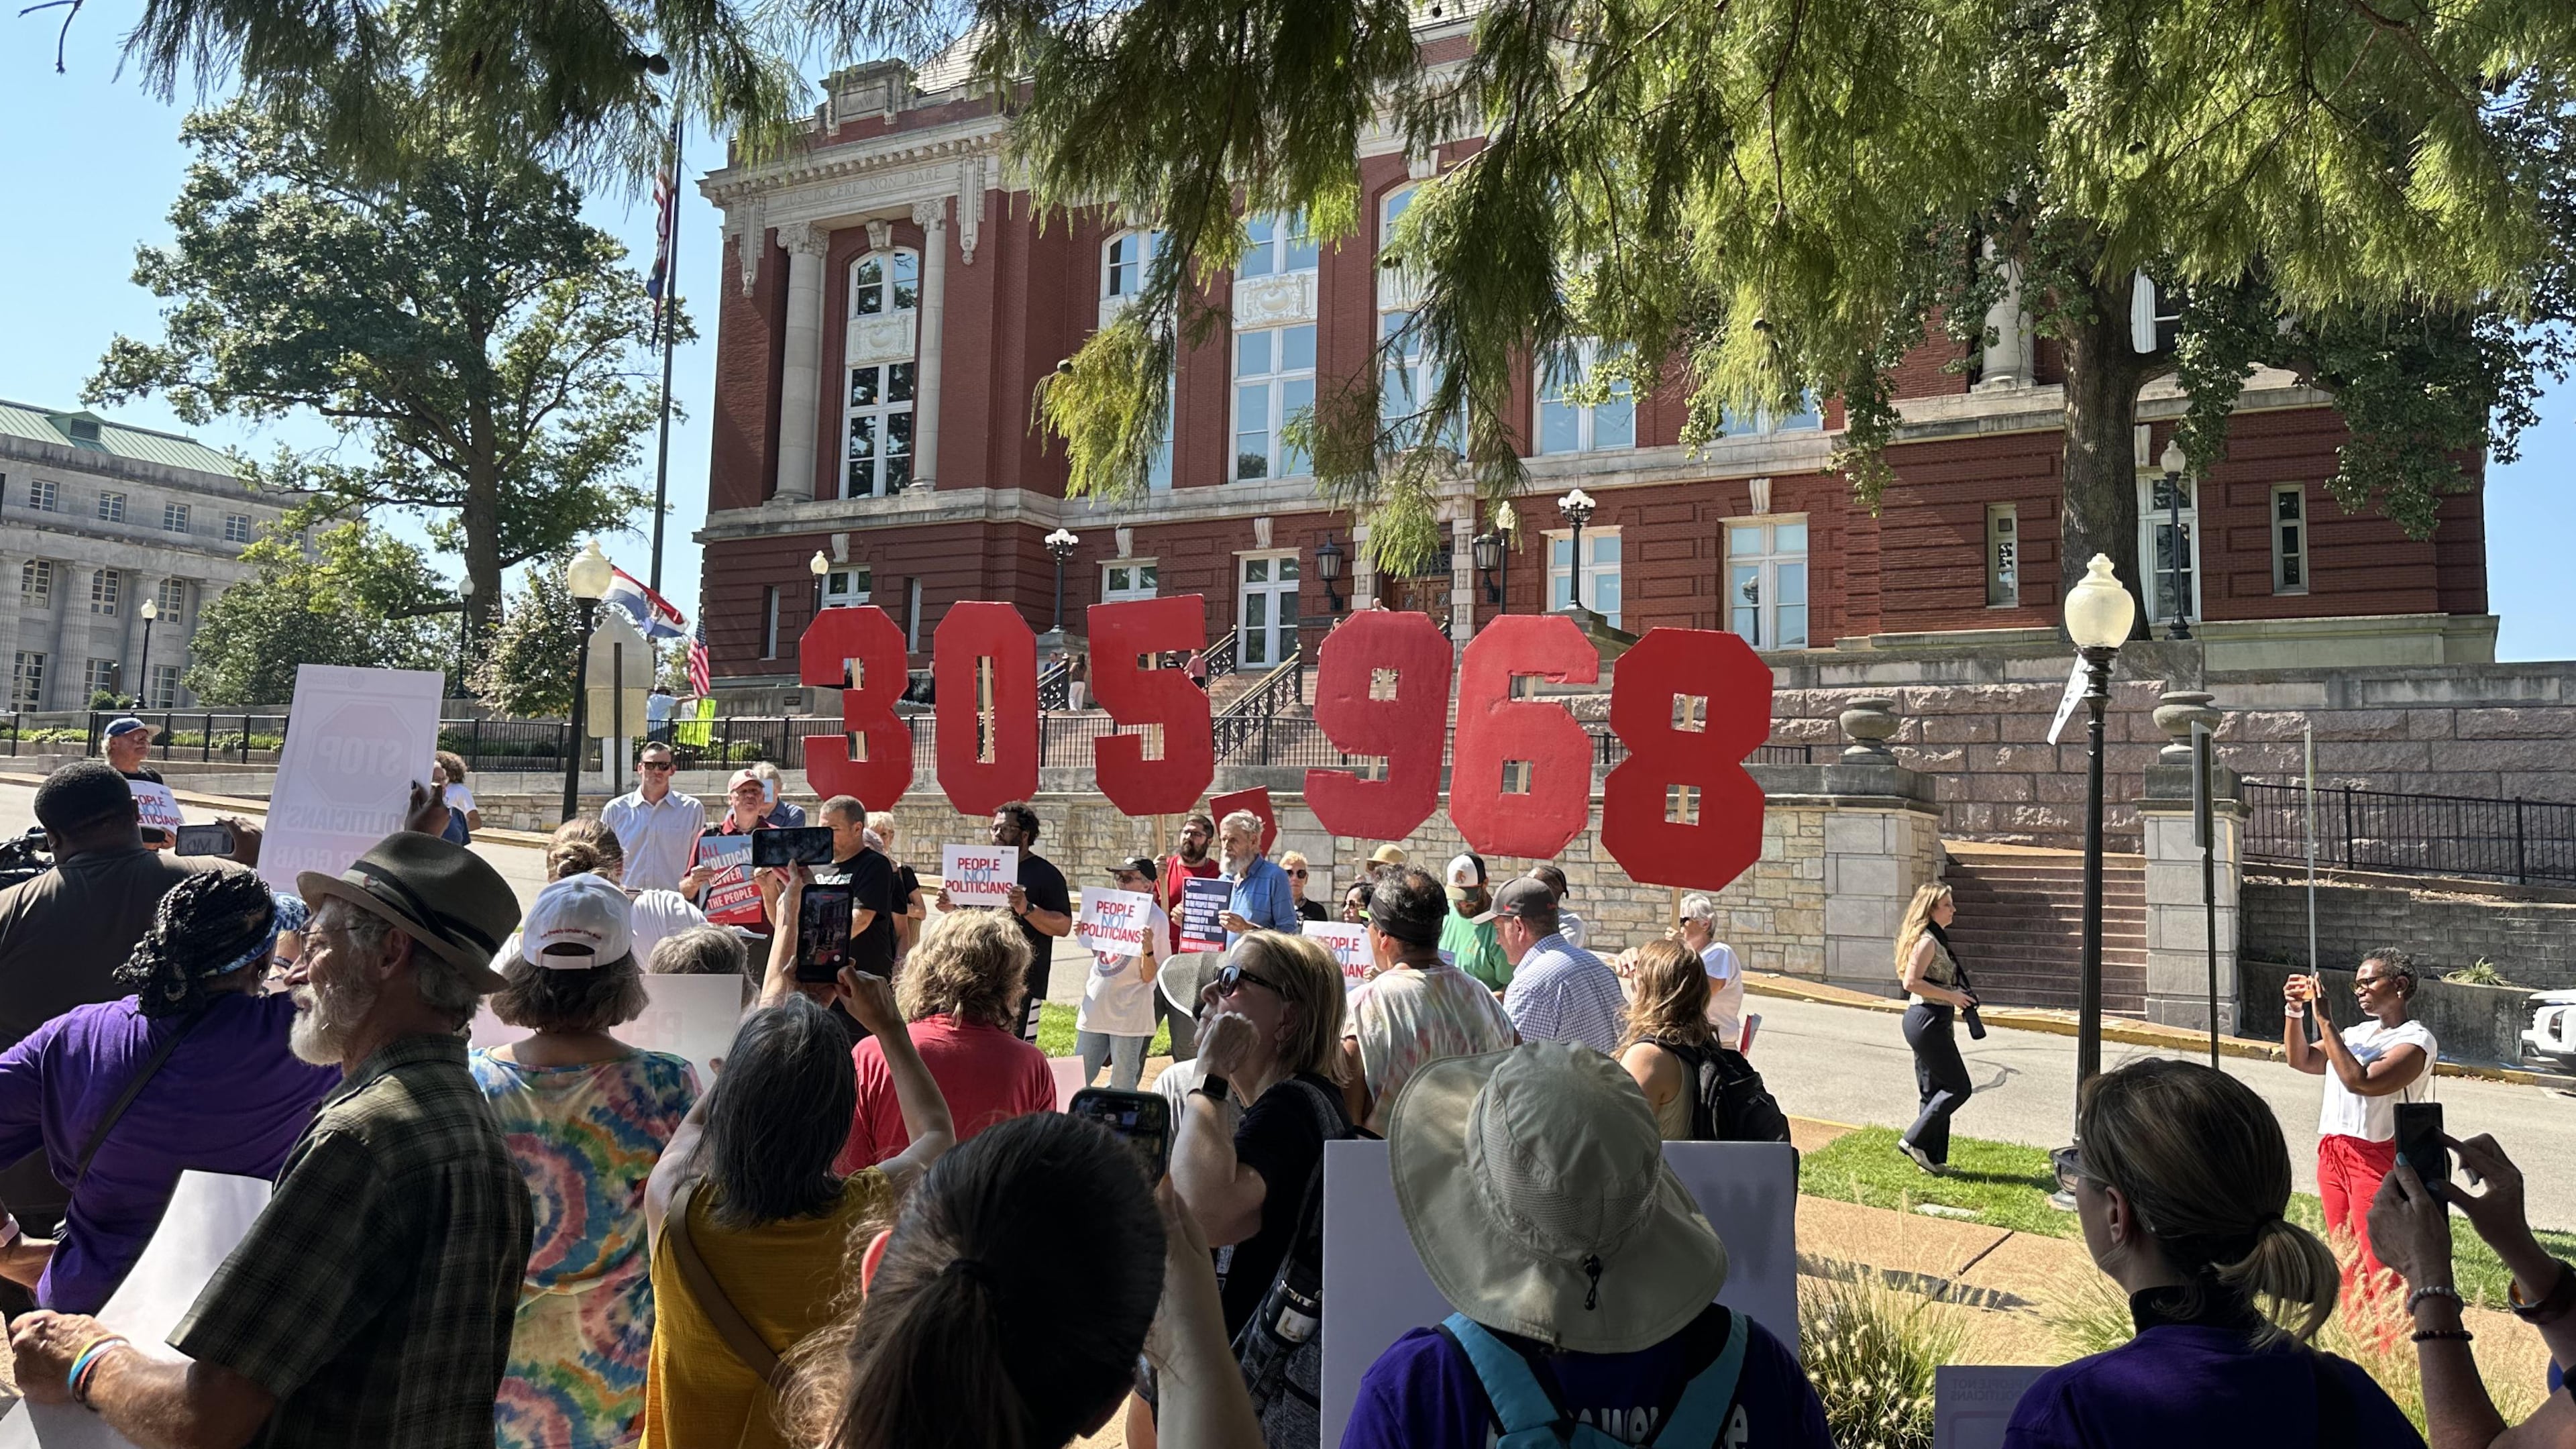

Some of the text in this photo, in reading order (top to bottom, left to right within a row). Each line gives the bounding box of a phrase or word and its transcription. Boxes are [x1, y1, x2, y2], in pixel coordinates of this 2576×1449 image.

[702, 843, 719, 858] ALL
[957, 857, 1000, 871] PEOPLE
[708, 866, 743, 886] POWER
[964, 867, 992, 884] NOT
[945, 880, 1013, 894] POLITICIANS
[708, 896, 724, 910] THE
[724, 887, 754, 905] PEOPLE
[1096, 900, 1135, 918] PEOPLE
[1101, 914, 1128, 928] NOT
[1081, 922, 1141, 943] POLITICIANS
